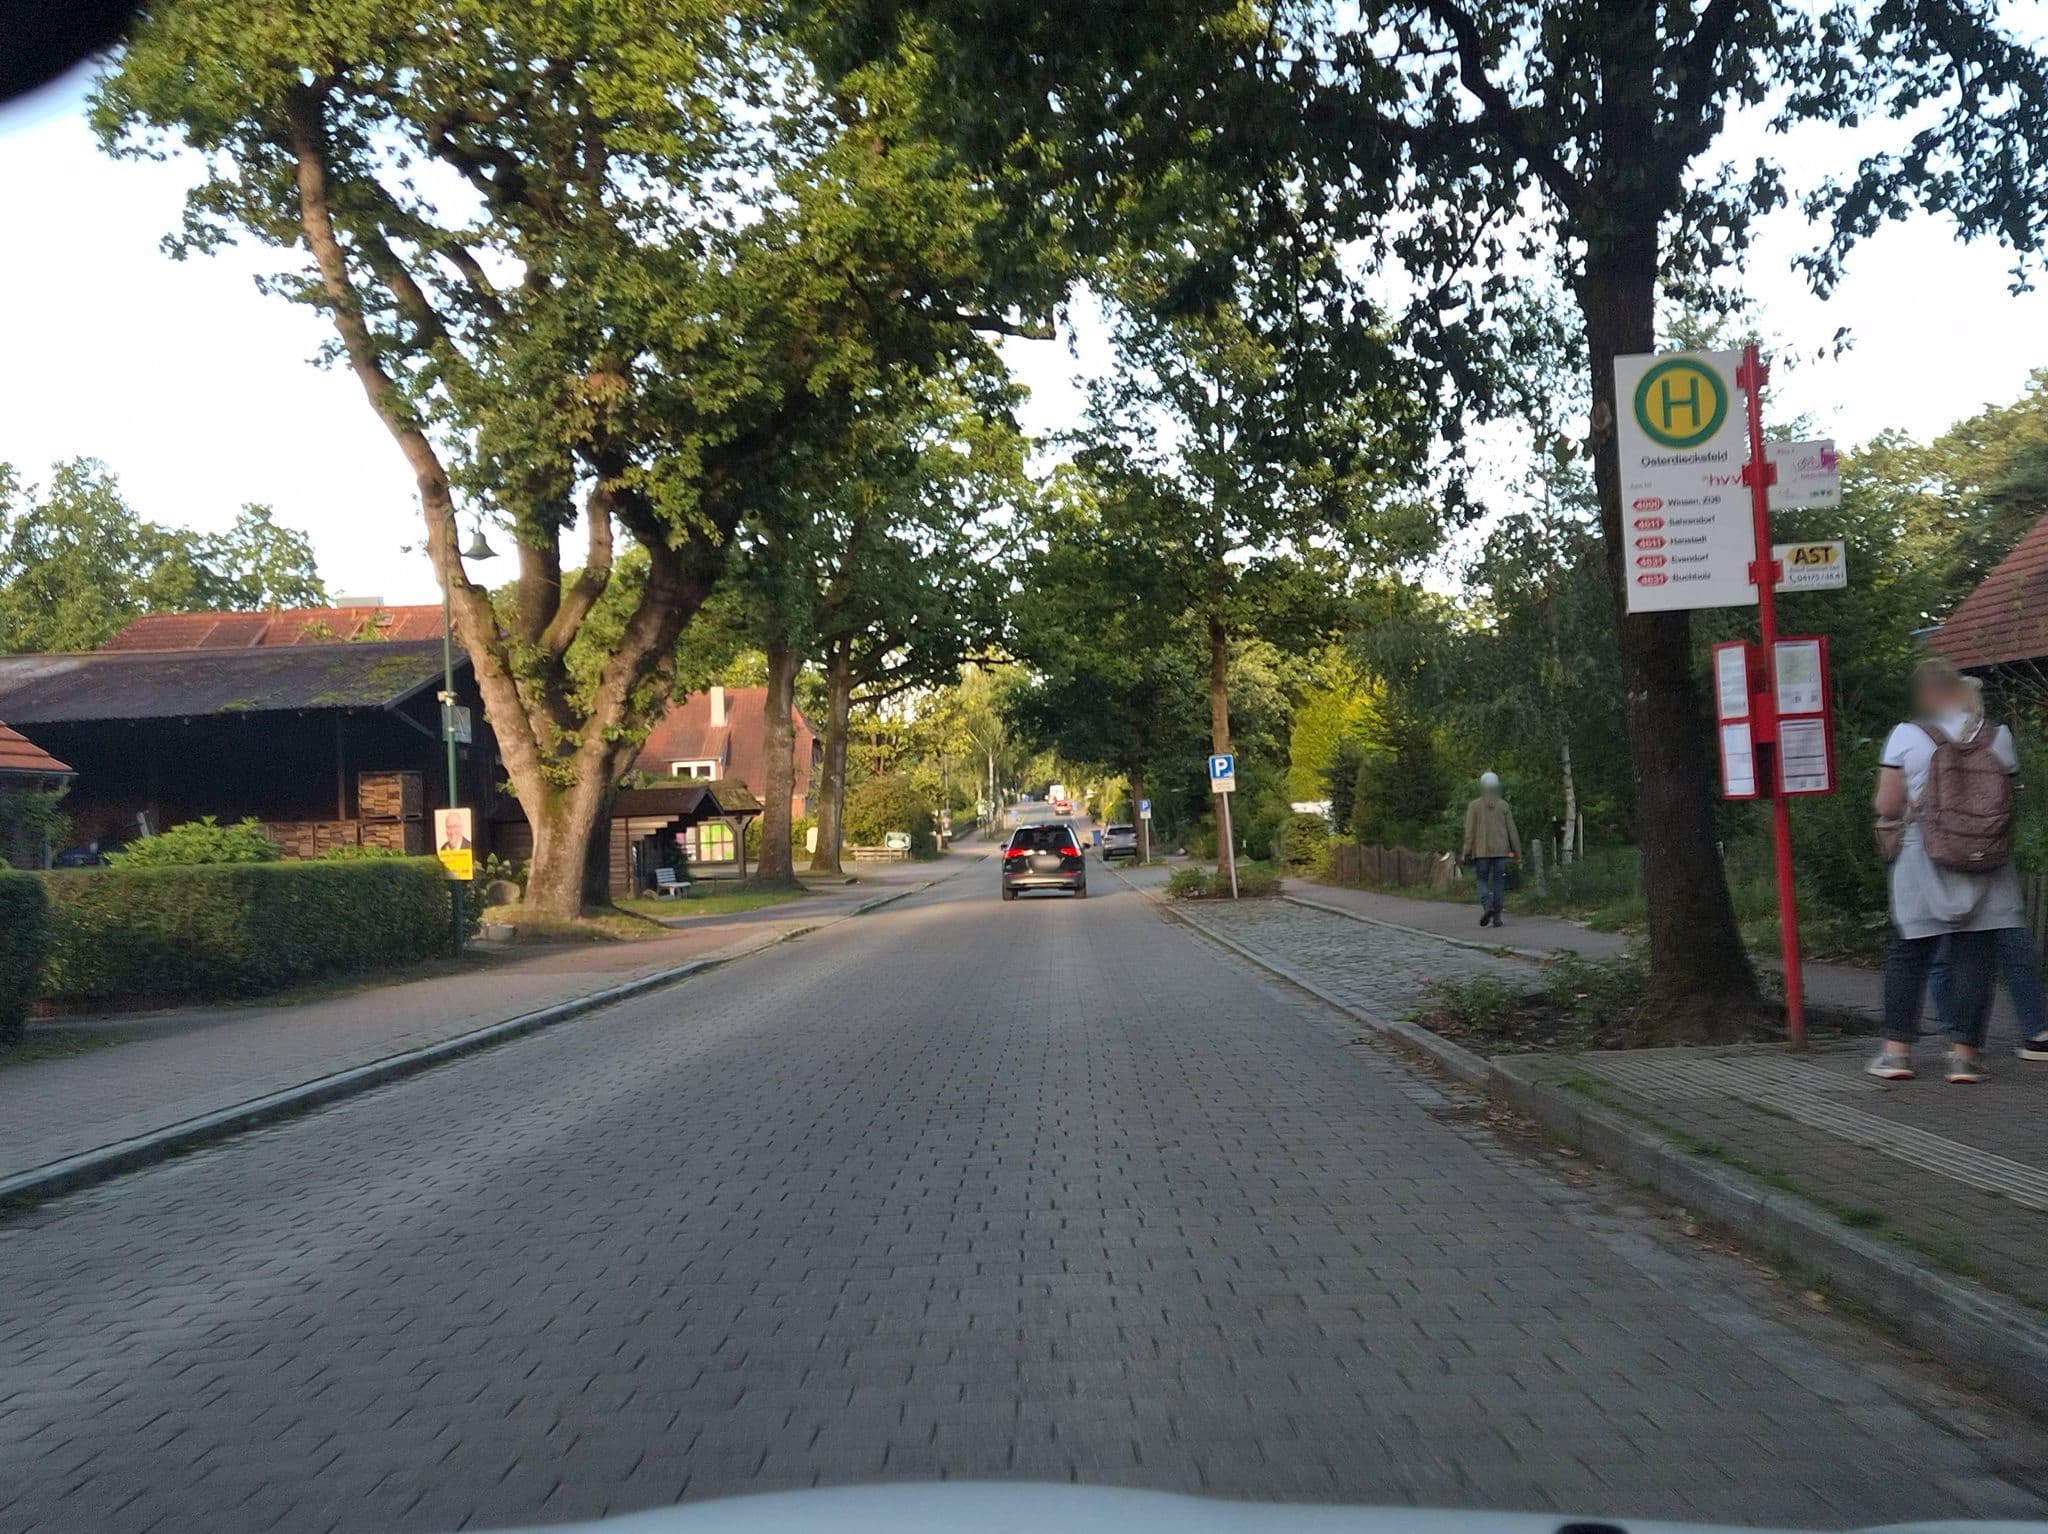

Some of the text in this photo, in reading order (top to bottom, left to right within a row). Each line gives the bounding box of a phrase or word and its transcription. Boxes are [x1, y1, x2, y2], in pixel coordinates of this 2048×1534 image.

[1662, 378, 1701, 428] H
[1794, 545, 1833, 565] AST
[1215, 758, 1228, 777] P
